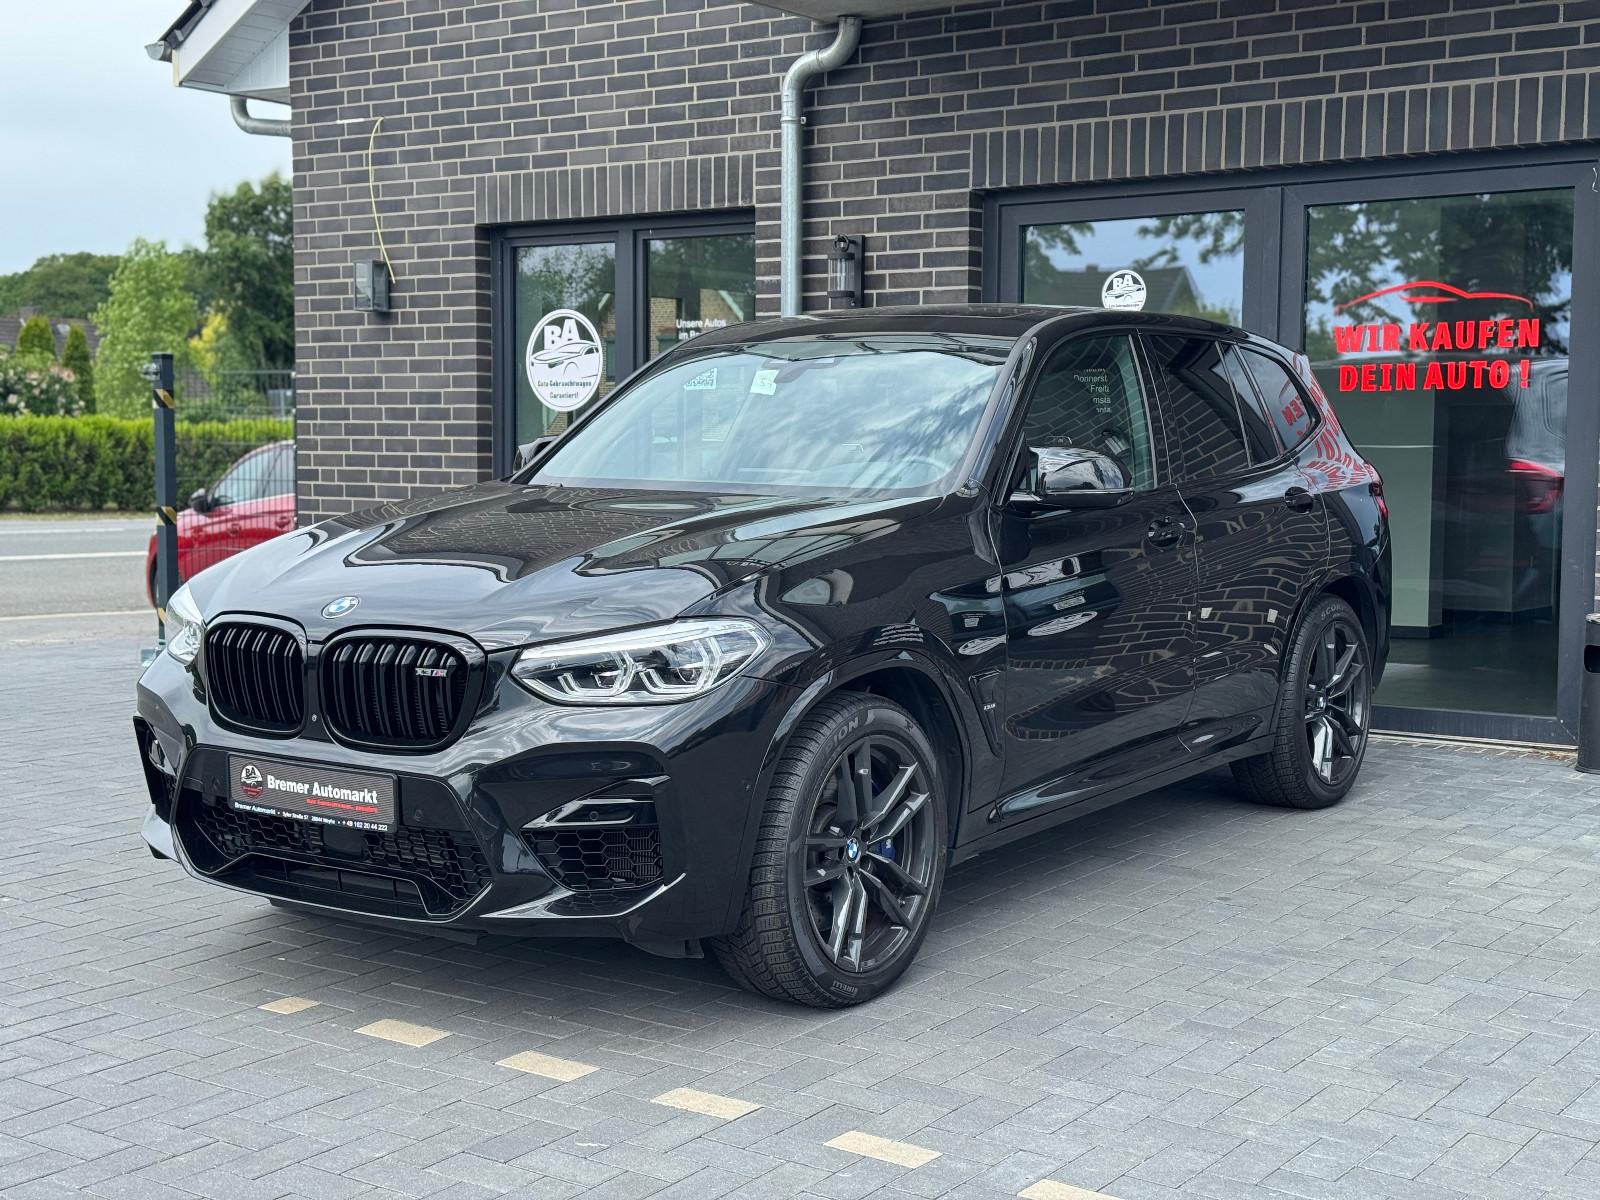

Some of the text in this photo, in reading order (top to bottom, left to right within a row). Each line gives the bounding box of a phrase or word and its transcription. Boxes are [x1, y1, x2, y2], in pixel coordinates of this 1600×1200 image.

[1112, 274, 1134, 291] BA
[676, 318, 727, 329] Unsere Autos
[544, 319, 580, 350] BA
[1334, 318, 1540, 353] WIR KAUFEN
[1073, 374, 1107, 382] Donnerst
[1339, 362, 1417, 392] DEIN
[1423, 360, 1510, 390] AUTO
[245, 767, 256, 777] BA
[266, 774, 310, 795] Bremer
[312, 781, 379, 804] Automarkt
[234, 801, 252, 811] Bremer
[251, 805, 276, 815] Automarkt
